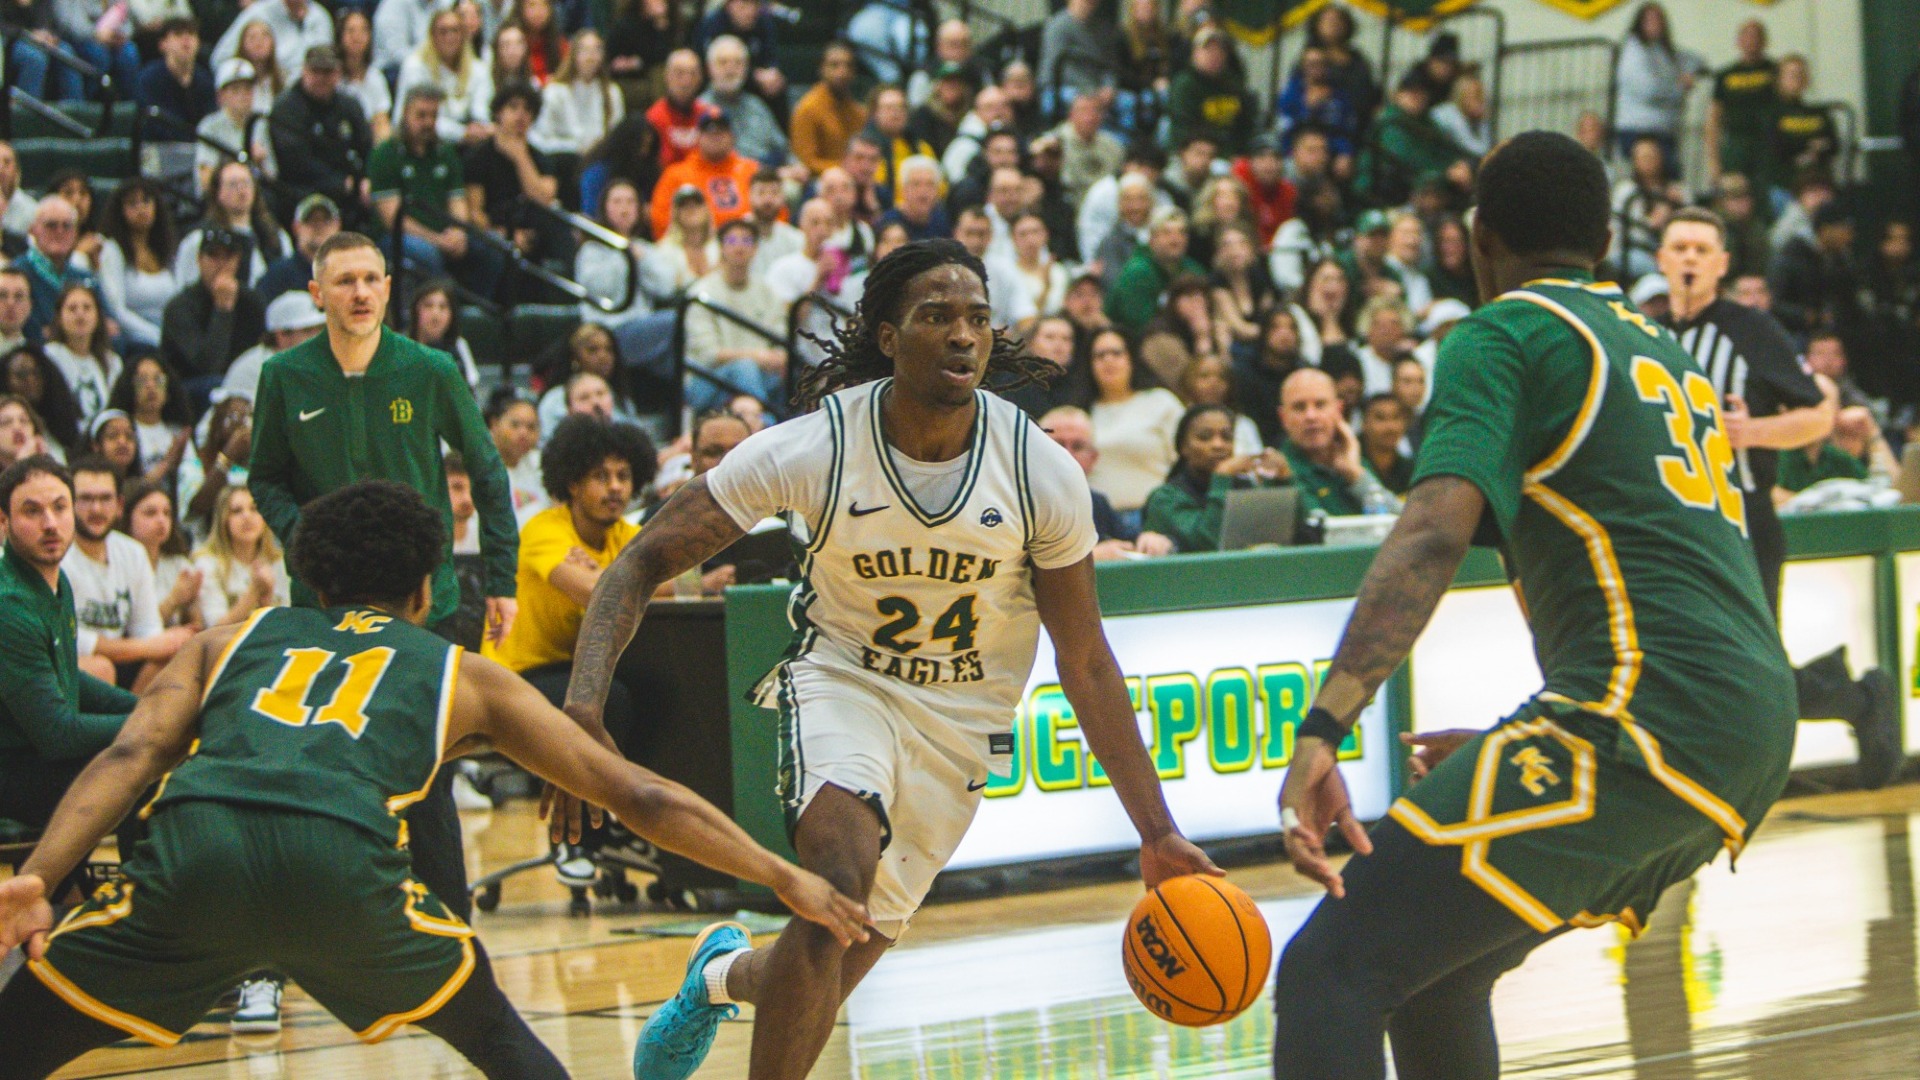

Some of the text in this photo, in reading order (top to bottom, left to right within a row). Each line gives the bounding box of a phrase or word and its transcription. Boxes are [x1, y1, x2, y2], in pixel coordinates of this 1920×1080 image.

[1629, 355, 1750, 538] 32
[852, 546, 1002, 584] GOLDEN
[872, 592, 981, 654] 24
[250, 645, 398, 741] 11
[861, 645, 985, 684] EAGLES
[1136, 914, 1186, 980] NCAA
